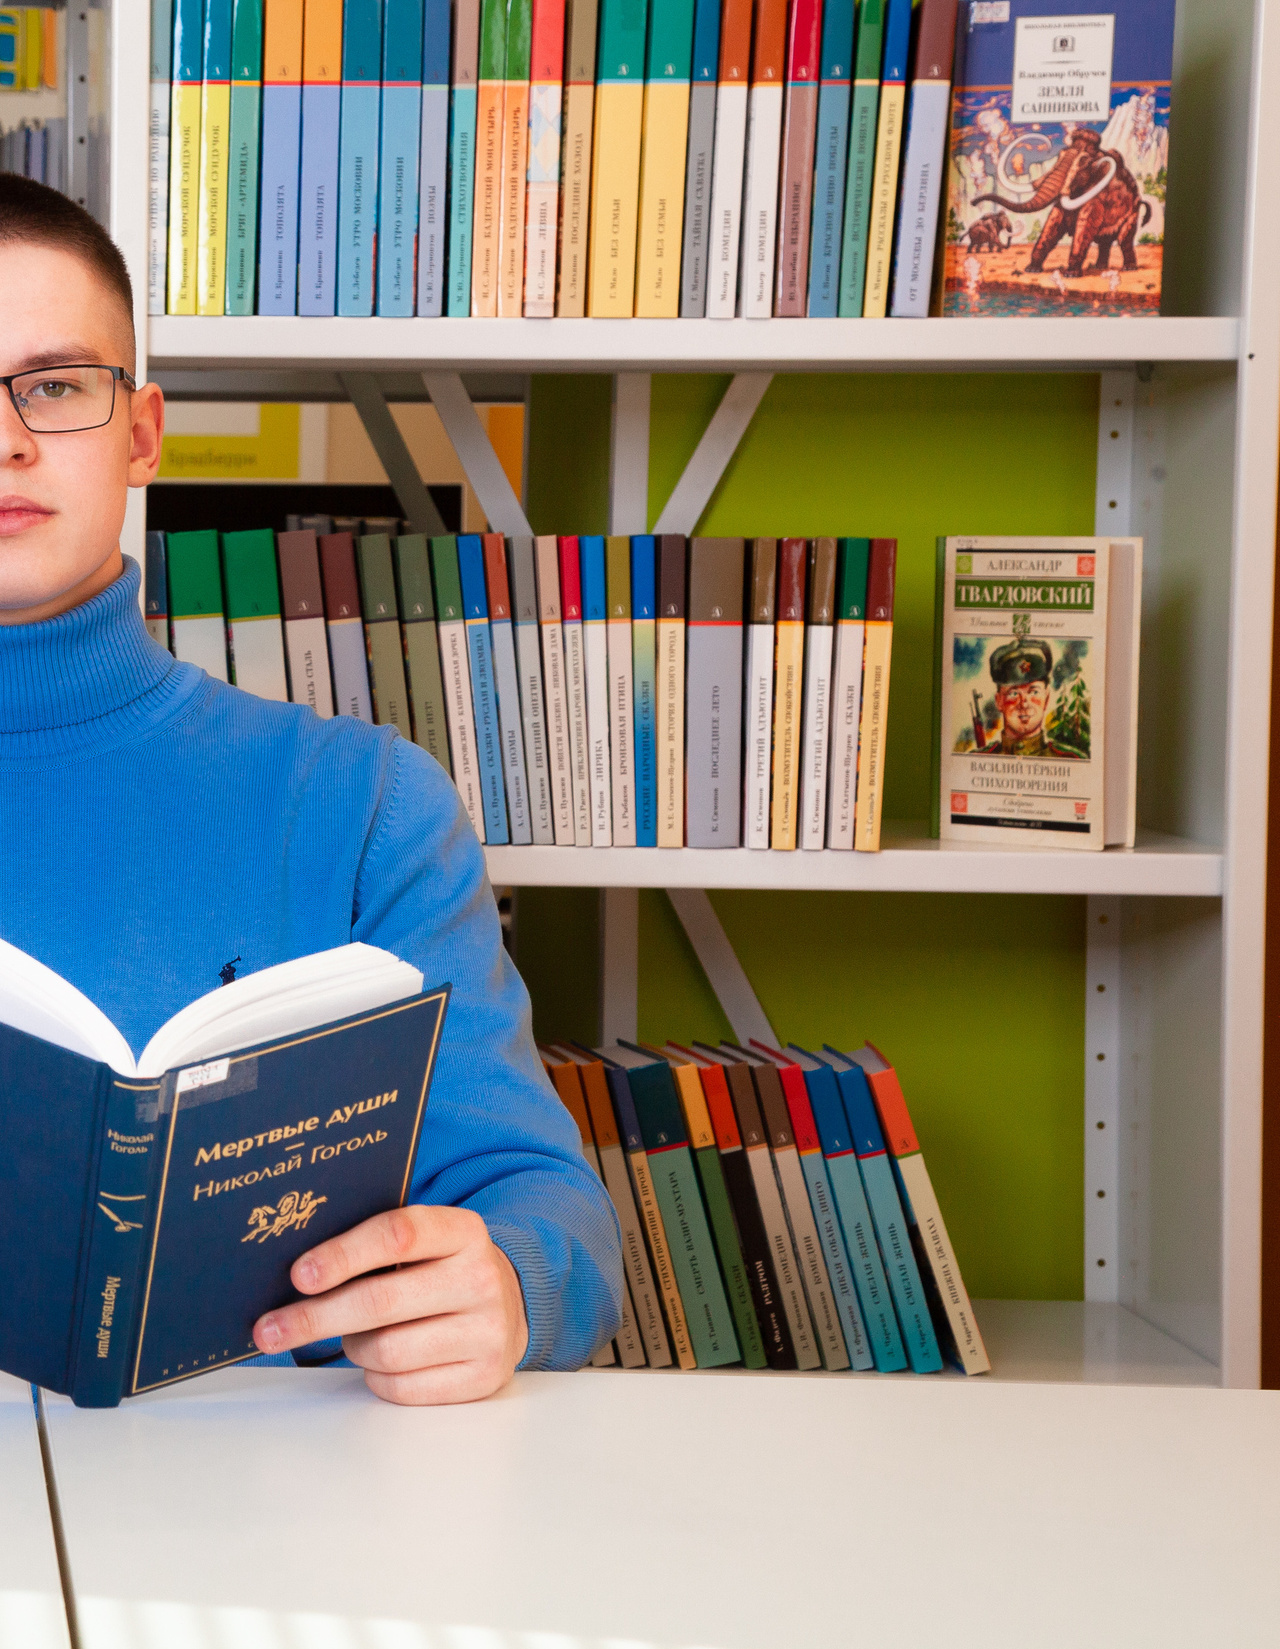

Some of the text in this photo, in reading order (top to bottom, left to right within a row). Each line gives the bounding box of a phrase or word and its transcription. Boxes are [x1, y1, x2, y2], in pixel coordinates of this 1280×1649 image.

[1022, 102, 1100, 114] САННИКОВА
[1038, 85, 1084, 97] ЗЕМЛЯ
[459, 132, 468, 224] СТИХОТВОРЕНИЯ
[182, 188, 191, 237] МОРСКОЙ
[988, 559, 1062, 573] АЛЕКСАНДР
[957, 584, 1091, 606] ТВАРДОВСКИЙ
[304, 651, 314, 678] СТАЛЬ
[475, 633, 488, 679] ЛЮДМИЛА
[480, 691, 492, 725] РУСЛАН
[529, 676, 544, 768] ЕВГЕНИЙ ОНЕГИН
[617, 675, 628, 775] БРОНЗОВАЯ ПТИЦА
[484, 733, 494, 767] СКАЗКИ
[508, 730, 518, 766] ПОЭМЫ
[711, 685, 721, 778] ПОСЛЕДНЕЕ ЛЕТО
[594, 740, 604, 780] ЛИРИКА
[971, 761, 1070, 777] ВАСИЛИЙ ТЁРКИН
[972, 778, 1068, 792] СТИХОТВОРЕНИЯ
[107, 1128, 154, 1143] Николай
[111, 1141, 147, 1154] Гоголь
[194, 1089, 397, 1166] Мертвые души
[193, 1129, 388, 1201] Николай Гоголь
[816, 1181, 849, 1297] ДИКАЯ СОБАКА ДИНГО
[855, 1222, 870, 1259] ЖИЗНЬ
[689, 1254, 706, 1295] СМЕРТЬ
[927, 1217, 961, 1304] КНЯЖНА ДЖАВАХА
[755, 1260, 773, 1305] РАЗГРОМ
[97, 1276, 120, 1358] Мертвые души
